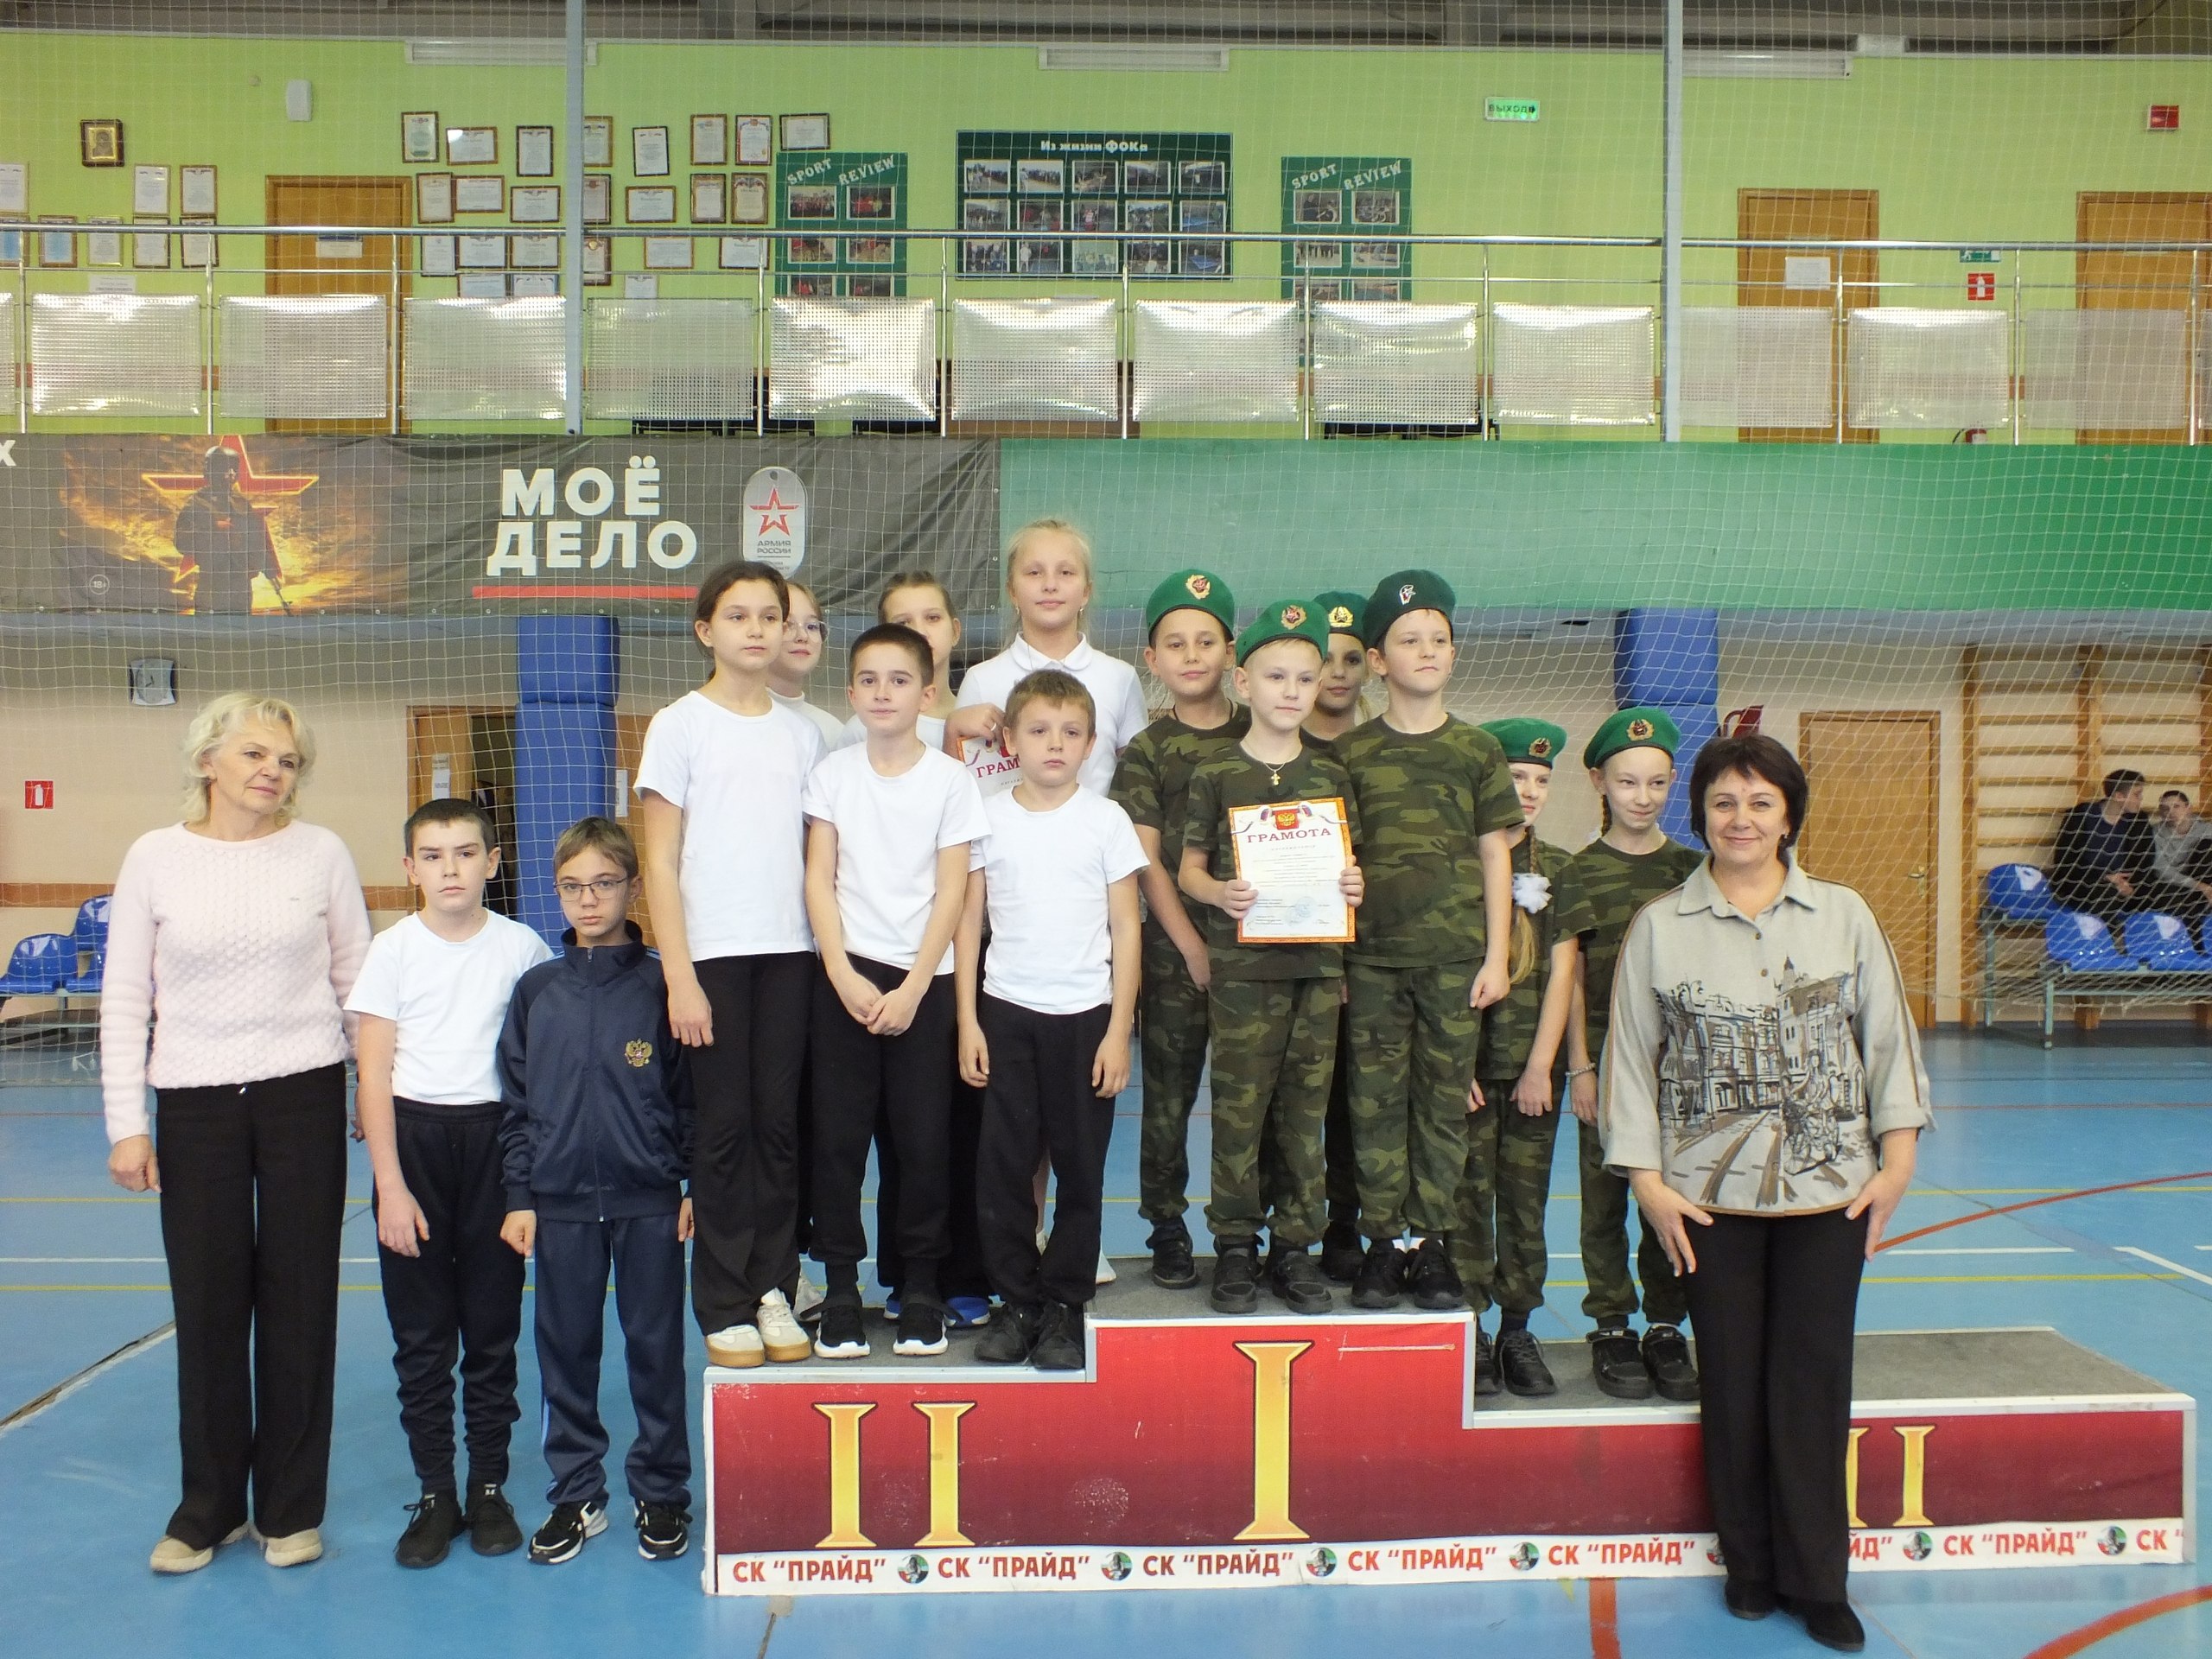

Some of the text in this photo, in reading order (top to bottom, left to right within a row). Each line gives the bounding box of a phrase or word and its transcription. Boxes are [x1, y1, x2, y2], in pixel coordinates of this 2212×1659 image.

[1488, 104, 1527, 112] ВЫХОД
[1040, 139, 1148, 154] Из жизни ФОКа
[787, 154, 896, 186] SPORT REVIEW
[1292, 158, 1402, 190] SPORT REVIEW
[501, 454, 661, 517] МОЁ
[486, 519, 698, 576] ДЕЛО
[976, 757, 1020, 779] ГРАМ
[1247, 828, 1332, 843] ГРАМОТА
[733, 1527, 2167, 1584] СК "ПРАЙД" СК "ПРАЙД" СК "ПРАЙД" СК "ПРАЙД" СК "ПРАЙД" СК "ПРАЙД" СК
